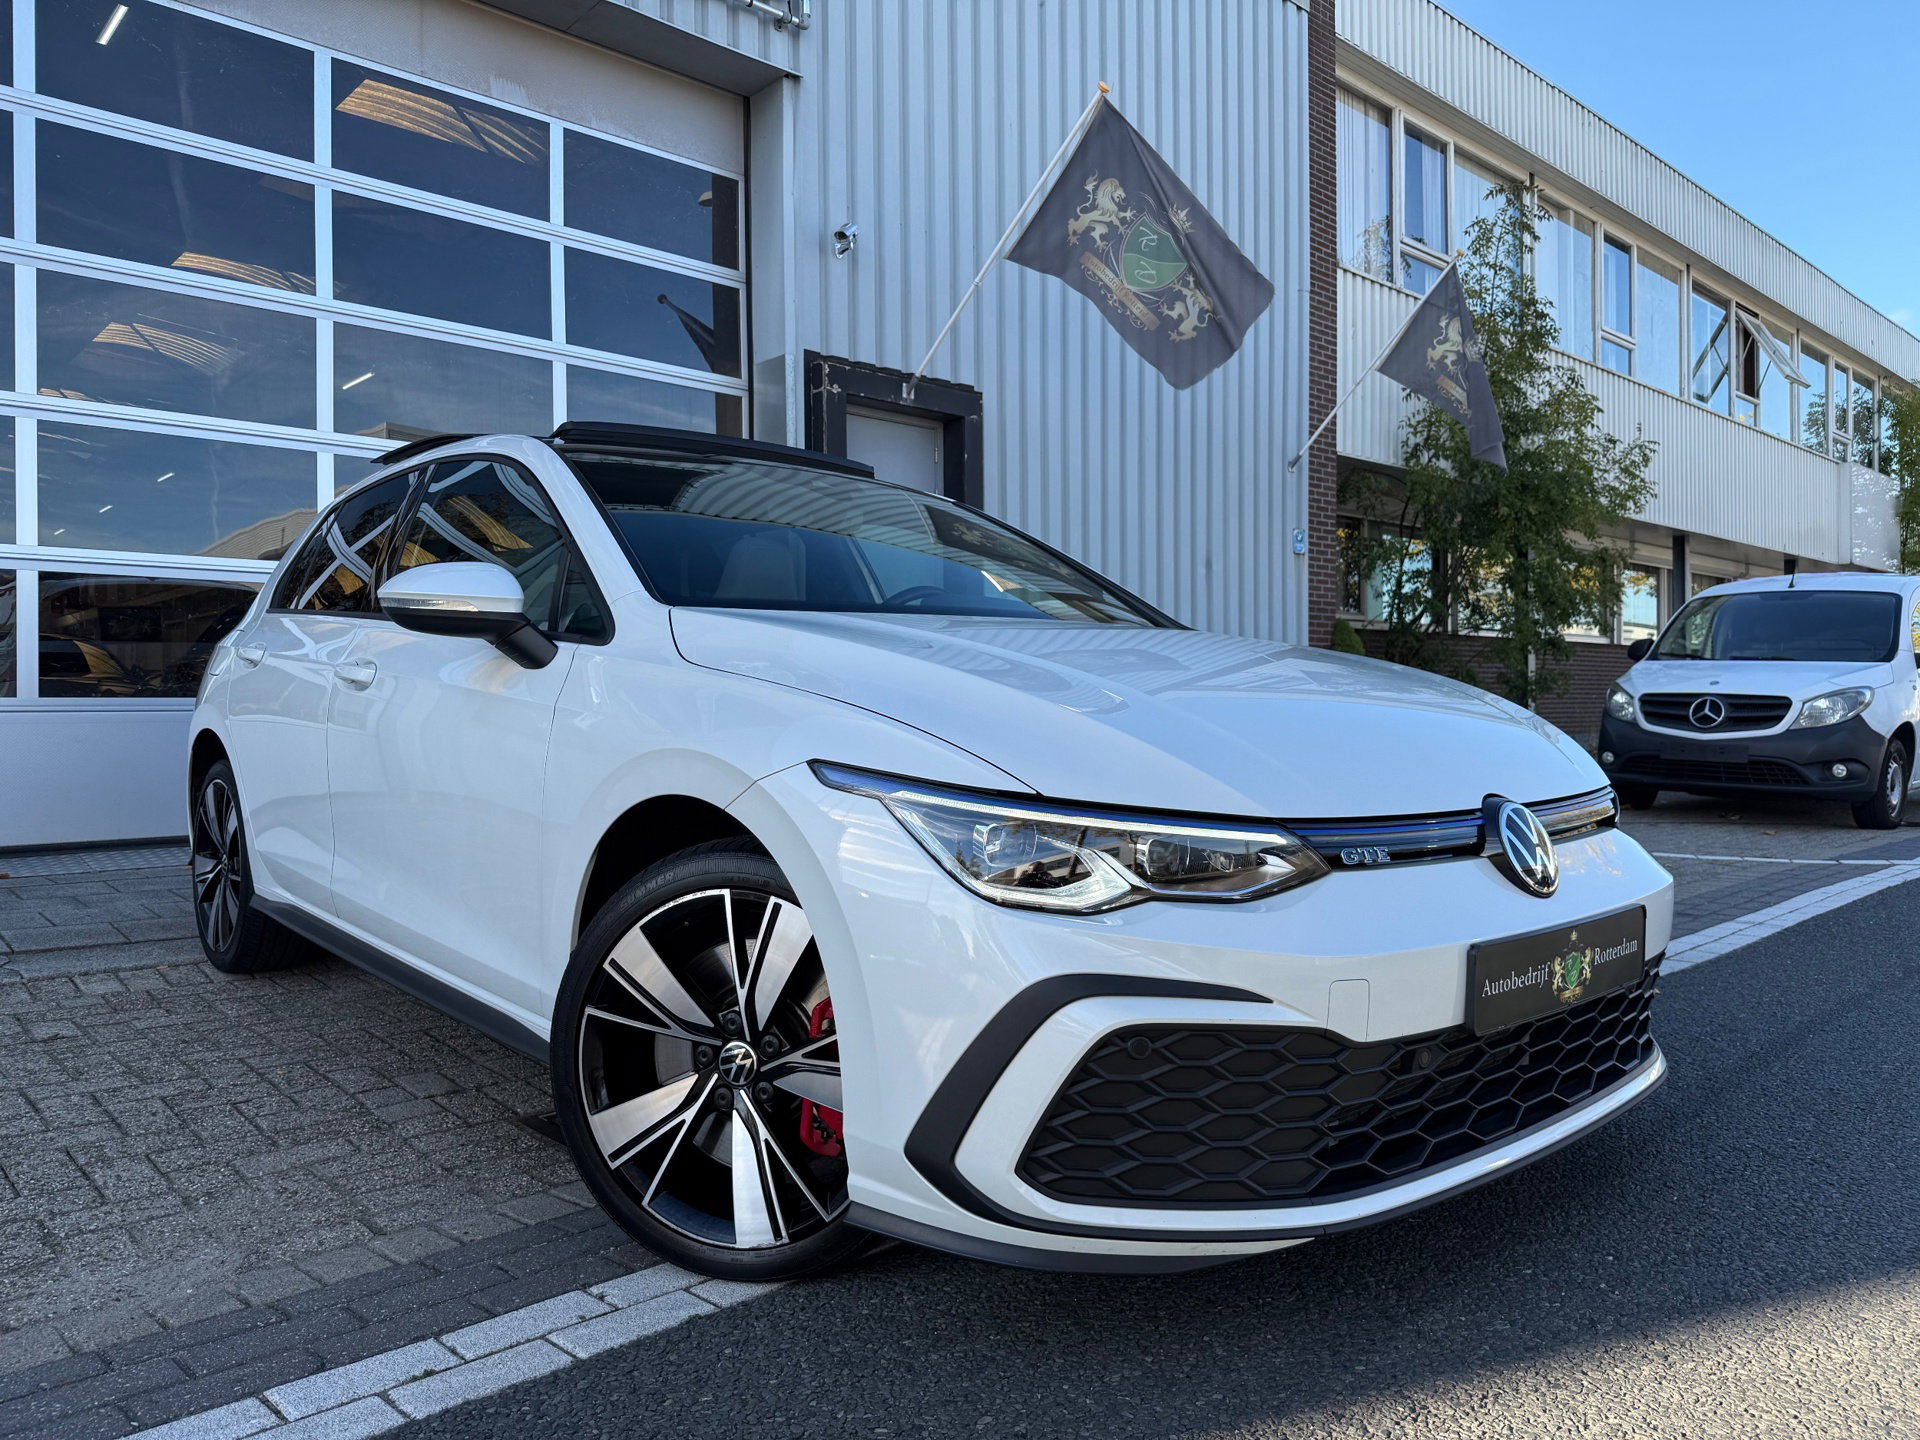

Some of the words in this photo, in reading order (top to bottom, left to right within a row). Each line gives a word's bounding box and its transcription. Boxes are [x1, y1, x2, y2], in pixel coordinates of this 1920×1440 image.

[1341, 847, 1391, 865] GTE
[1481, 961, 1551, 997] Autobedrijf
[1593, 938, 1638, 965] Rotterdam
